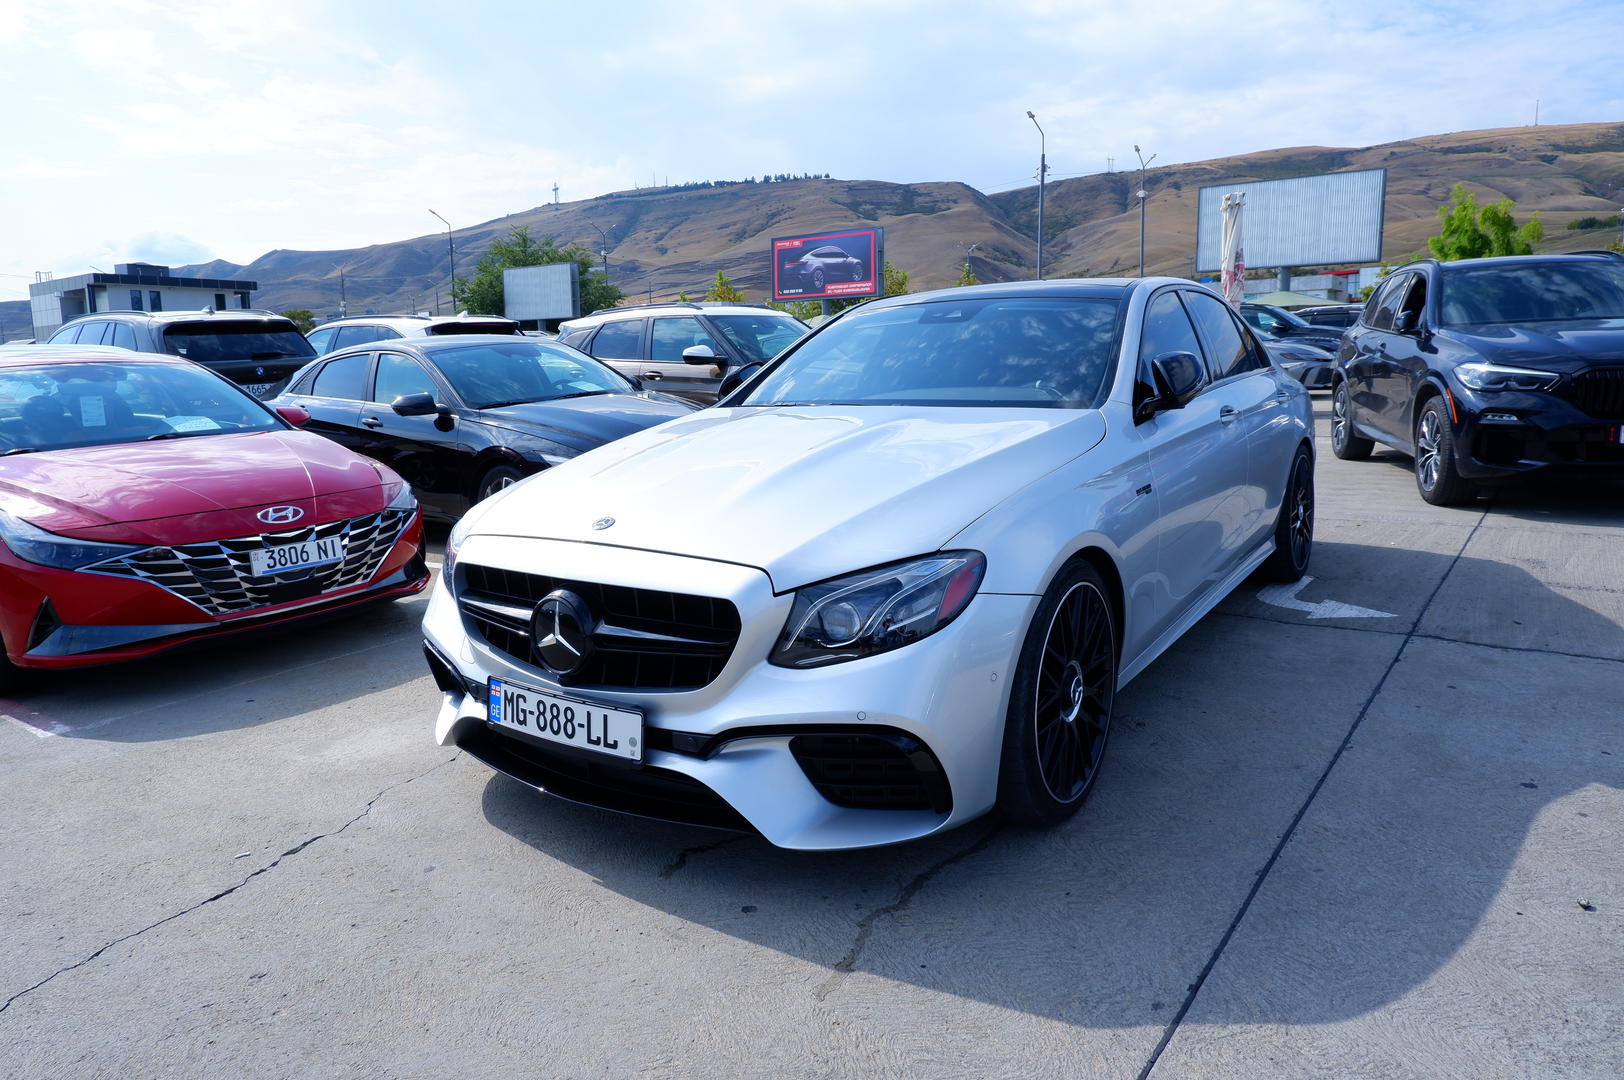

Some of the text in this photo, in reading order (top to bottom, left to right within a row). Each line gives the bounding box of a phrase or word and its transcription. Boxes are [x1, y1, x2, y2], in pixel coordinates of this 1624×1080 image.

[246, 384, 267, 395] 1665
[265, 539, 337, 569] 3806 NI
[490, 704, 500, 717] GE
[503, 689, 618, 750] MG-888-LL
